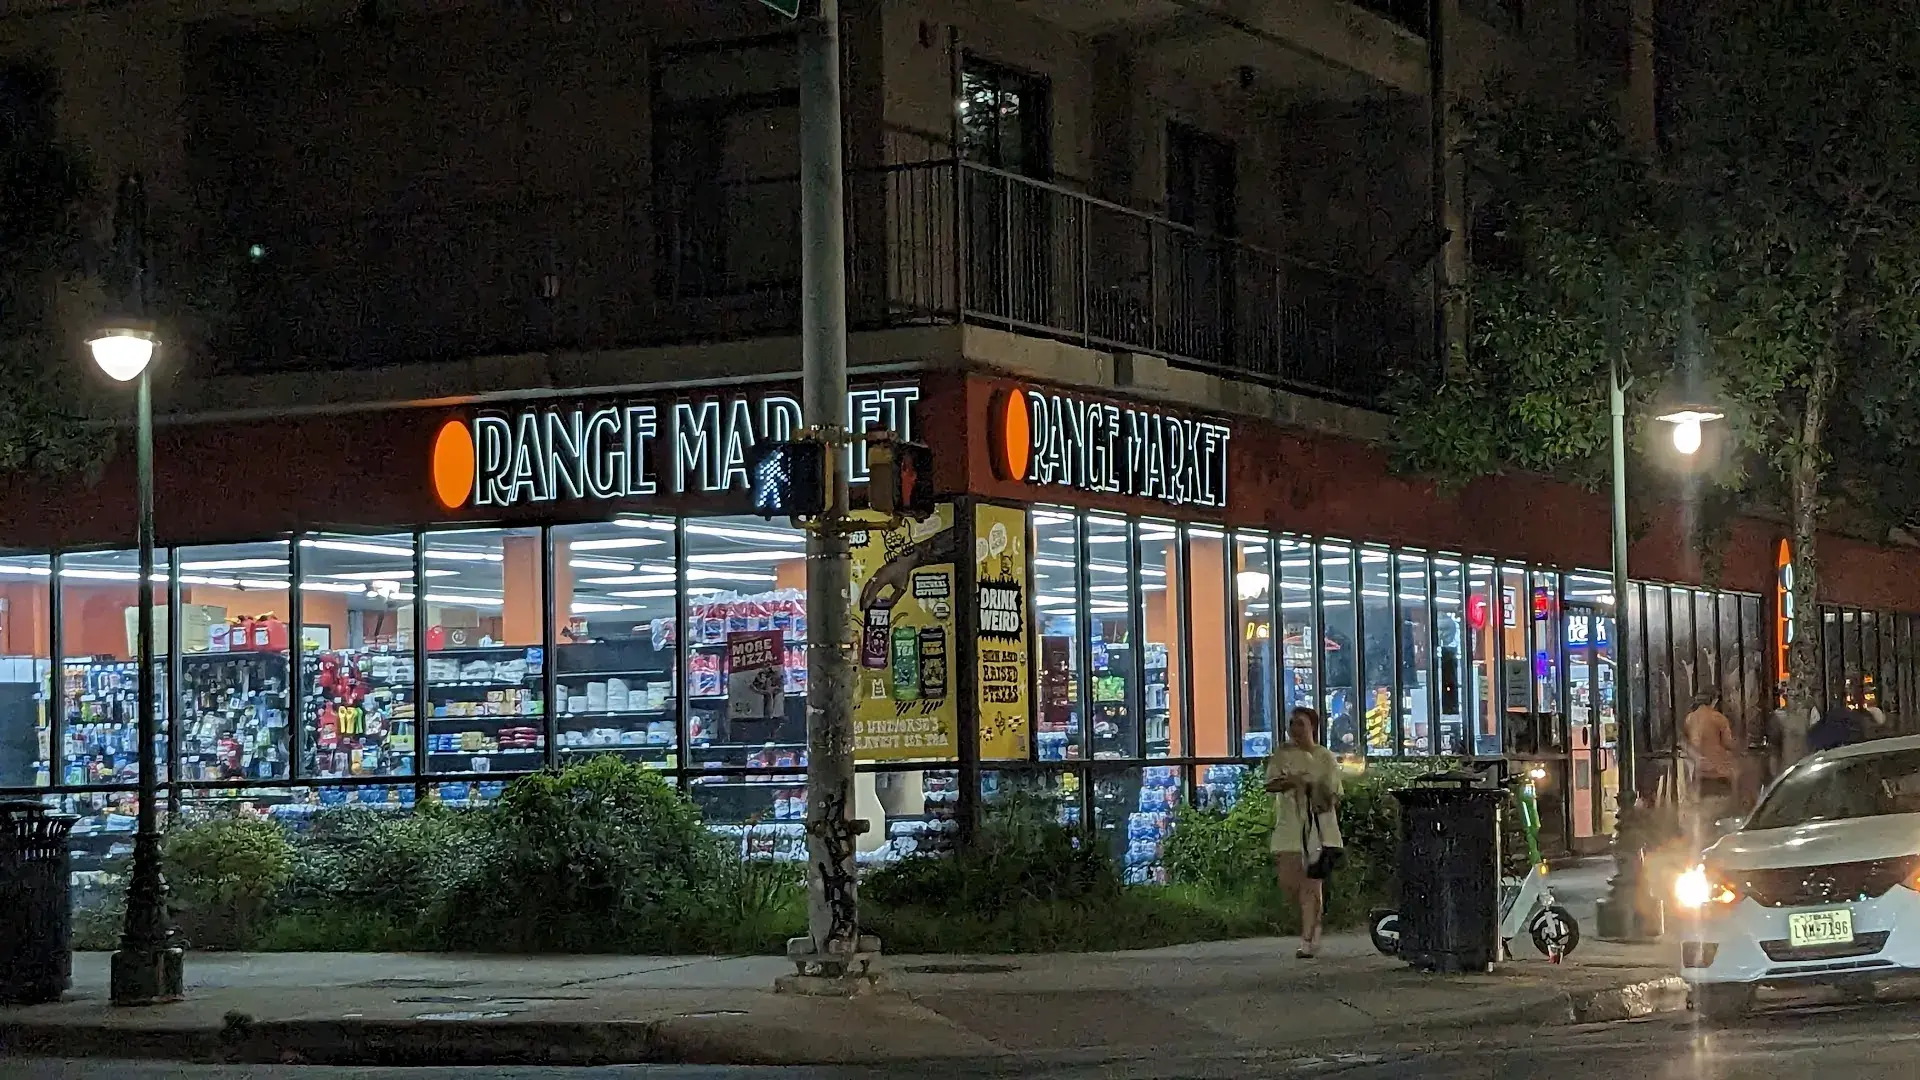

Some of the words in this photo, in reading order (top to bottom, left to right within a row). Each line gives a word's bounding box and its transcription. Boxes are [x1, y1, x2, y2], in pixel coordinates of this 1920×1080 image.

[1126, 409, 1231, 507] MARKET
[980, 587, 1018, 611] DRINK
[980, 609, 1020, 632] WEIRD
[732, 638, 772, 656] MORE
